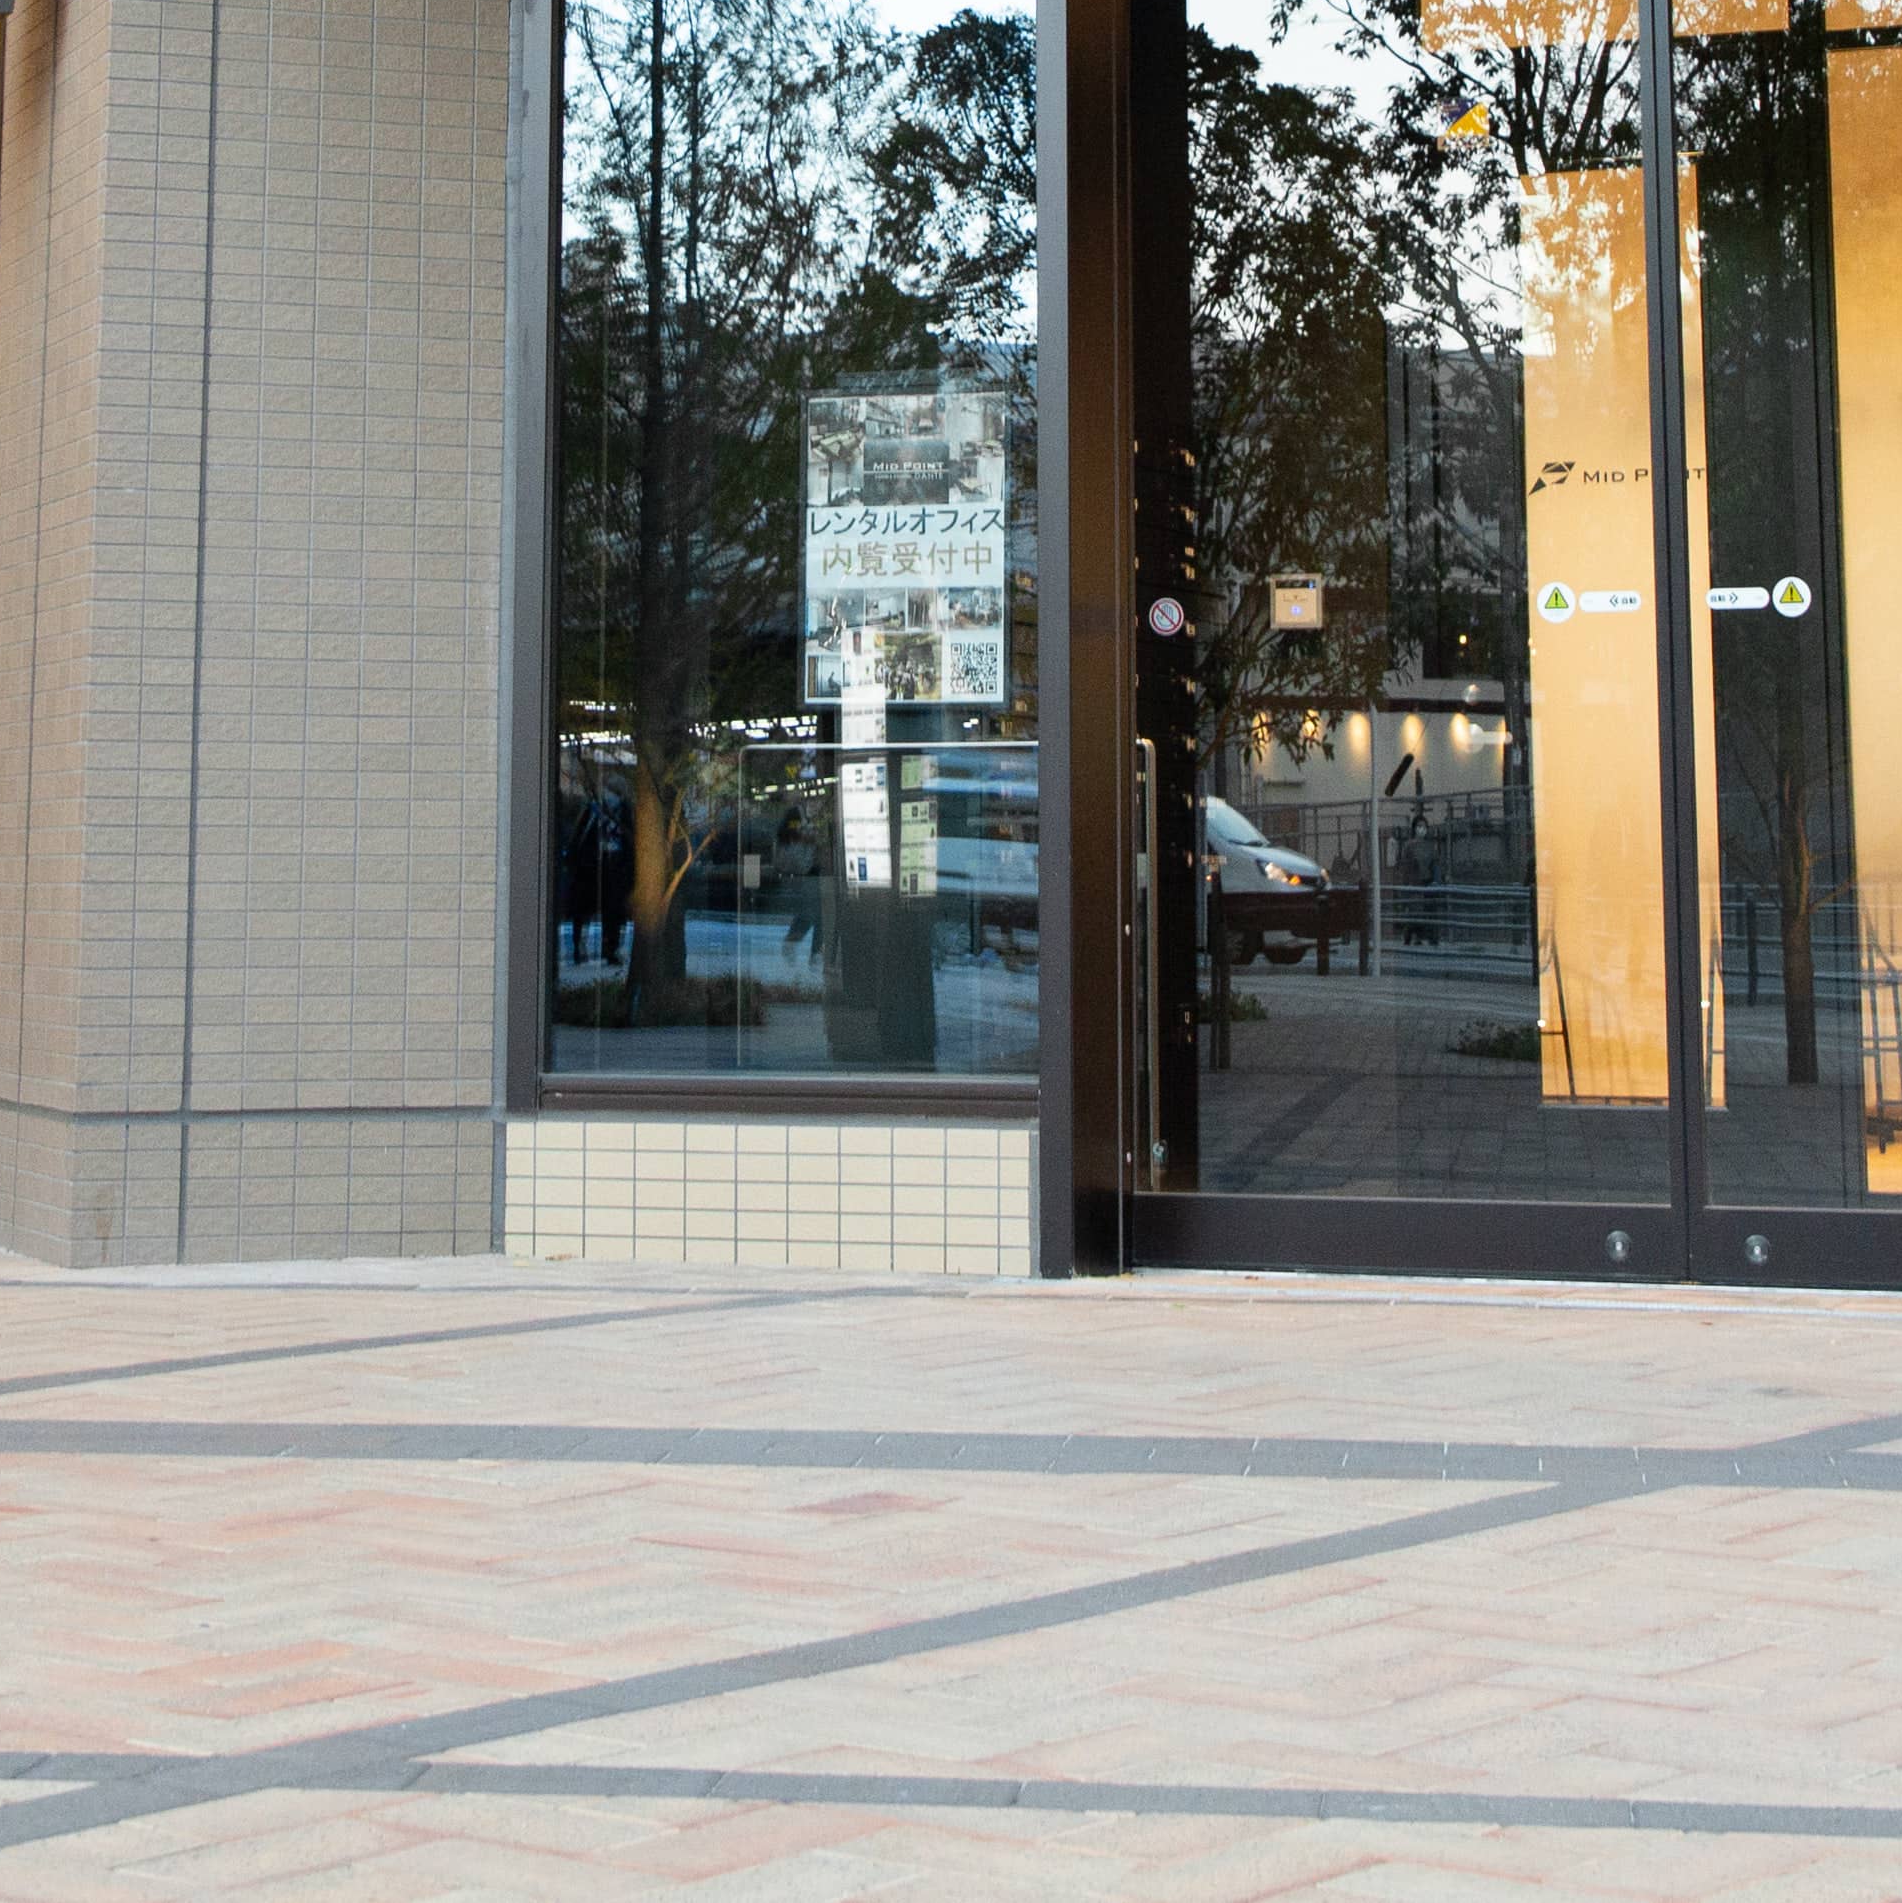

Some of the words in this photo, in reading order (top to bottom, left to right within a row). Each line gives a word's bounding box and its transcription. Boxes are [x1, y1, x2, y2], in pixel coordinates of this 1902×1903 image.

[873, 462, 898, 472] MID
[903, 461, 944, 472] POINT
[1583, 470, 1625, 484] MID
[811, 506, 1005, 536] レンタルオフィス
[822, 540, 992, 576] 内覧受付中
